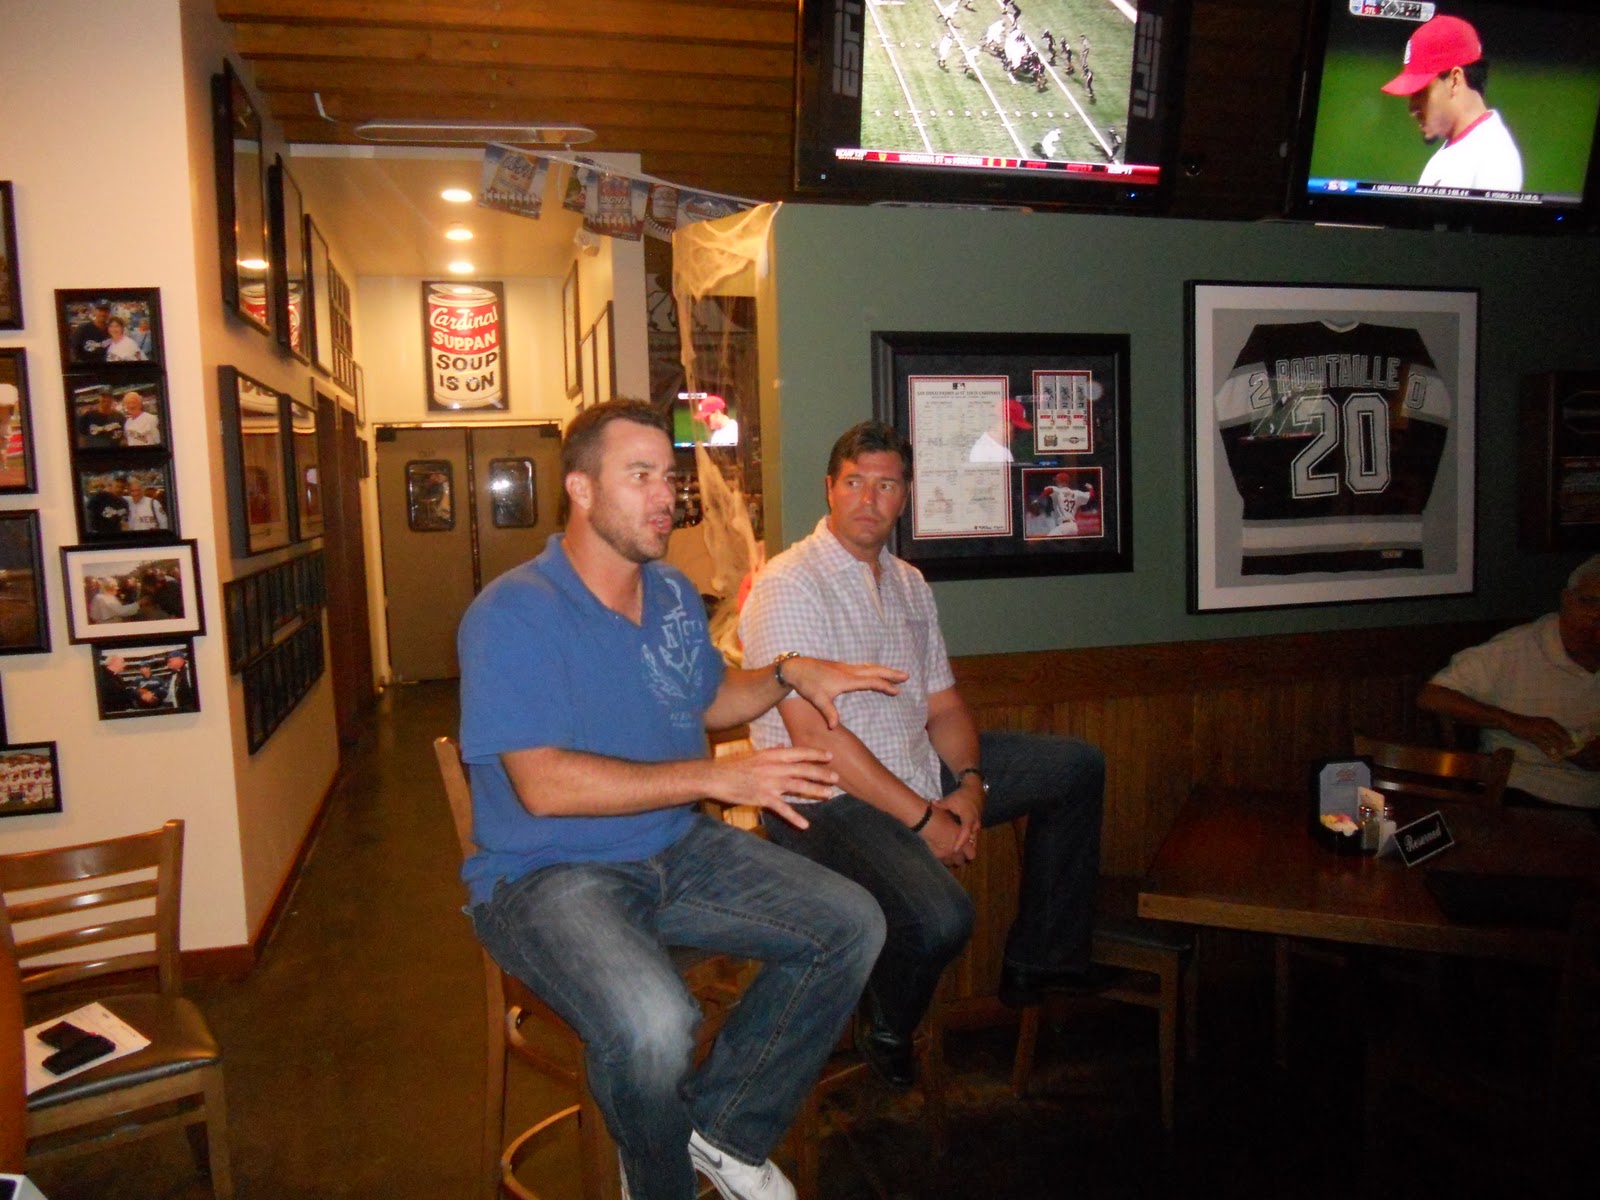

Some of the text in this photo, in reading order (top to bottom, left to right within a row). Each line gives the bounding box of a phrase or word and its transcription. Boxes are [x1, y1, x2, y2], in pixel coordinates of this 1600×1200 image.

[1131, 10, 1163, 120] ESPN
[430, 306, 499, 332] Cardinal
[433, 330, 496, 351] SUPPAN
[436, 351, 498, 371] SOUP
[1275, 353, 1401, 394] ROBITAILLE
[440, 372, 494, 392] IS ON
[1249, 371, 1273, 410] 2
[1404, 373, 1427, 410] 0
[1291, 393, 1392, 499] 20
[1063, 499, 1076, 513] 37
